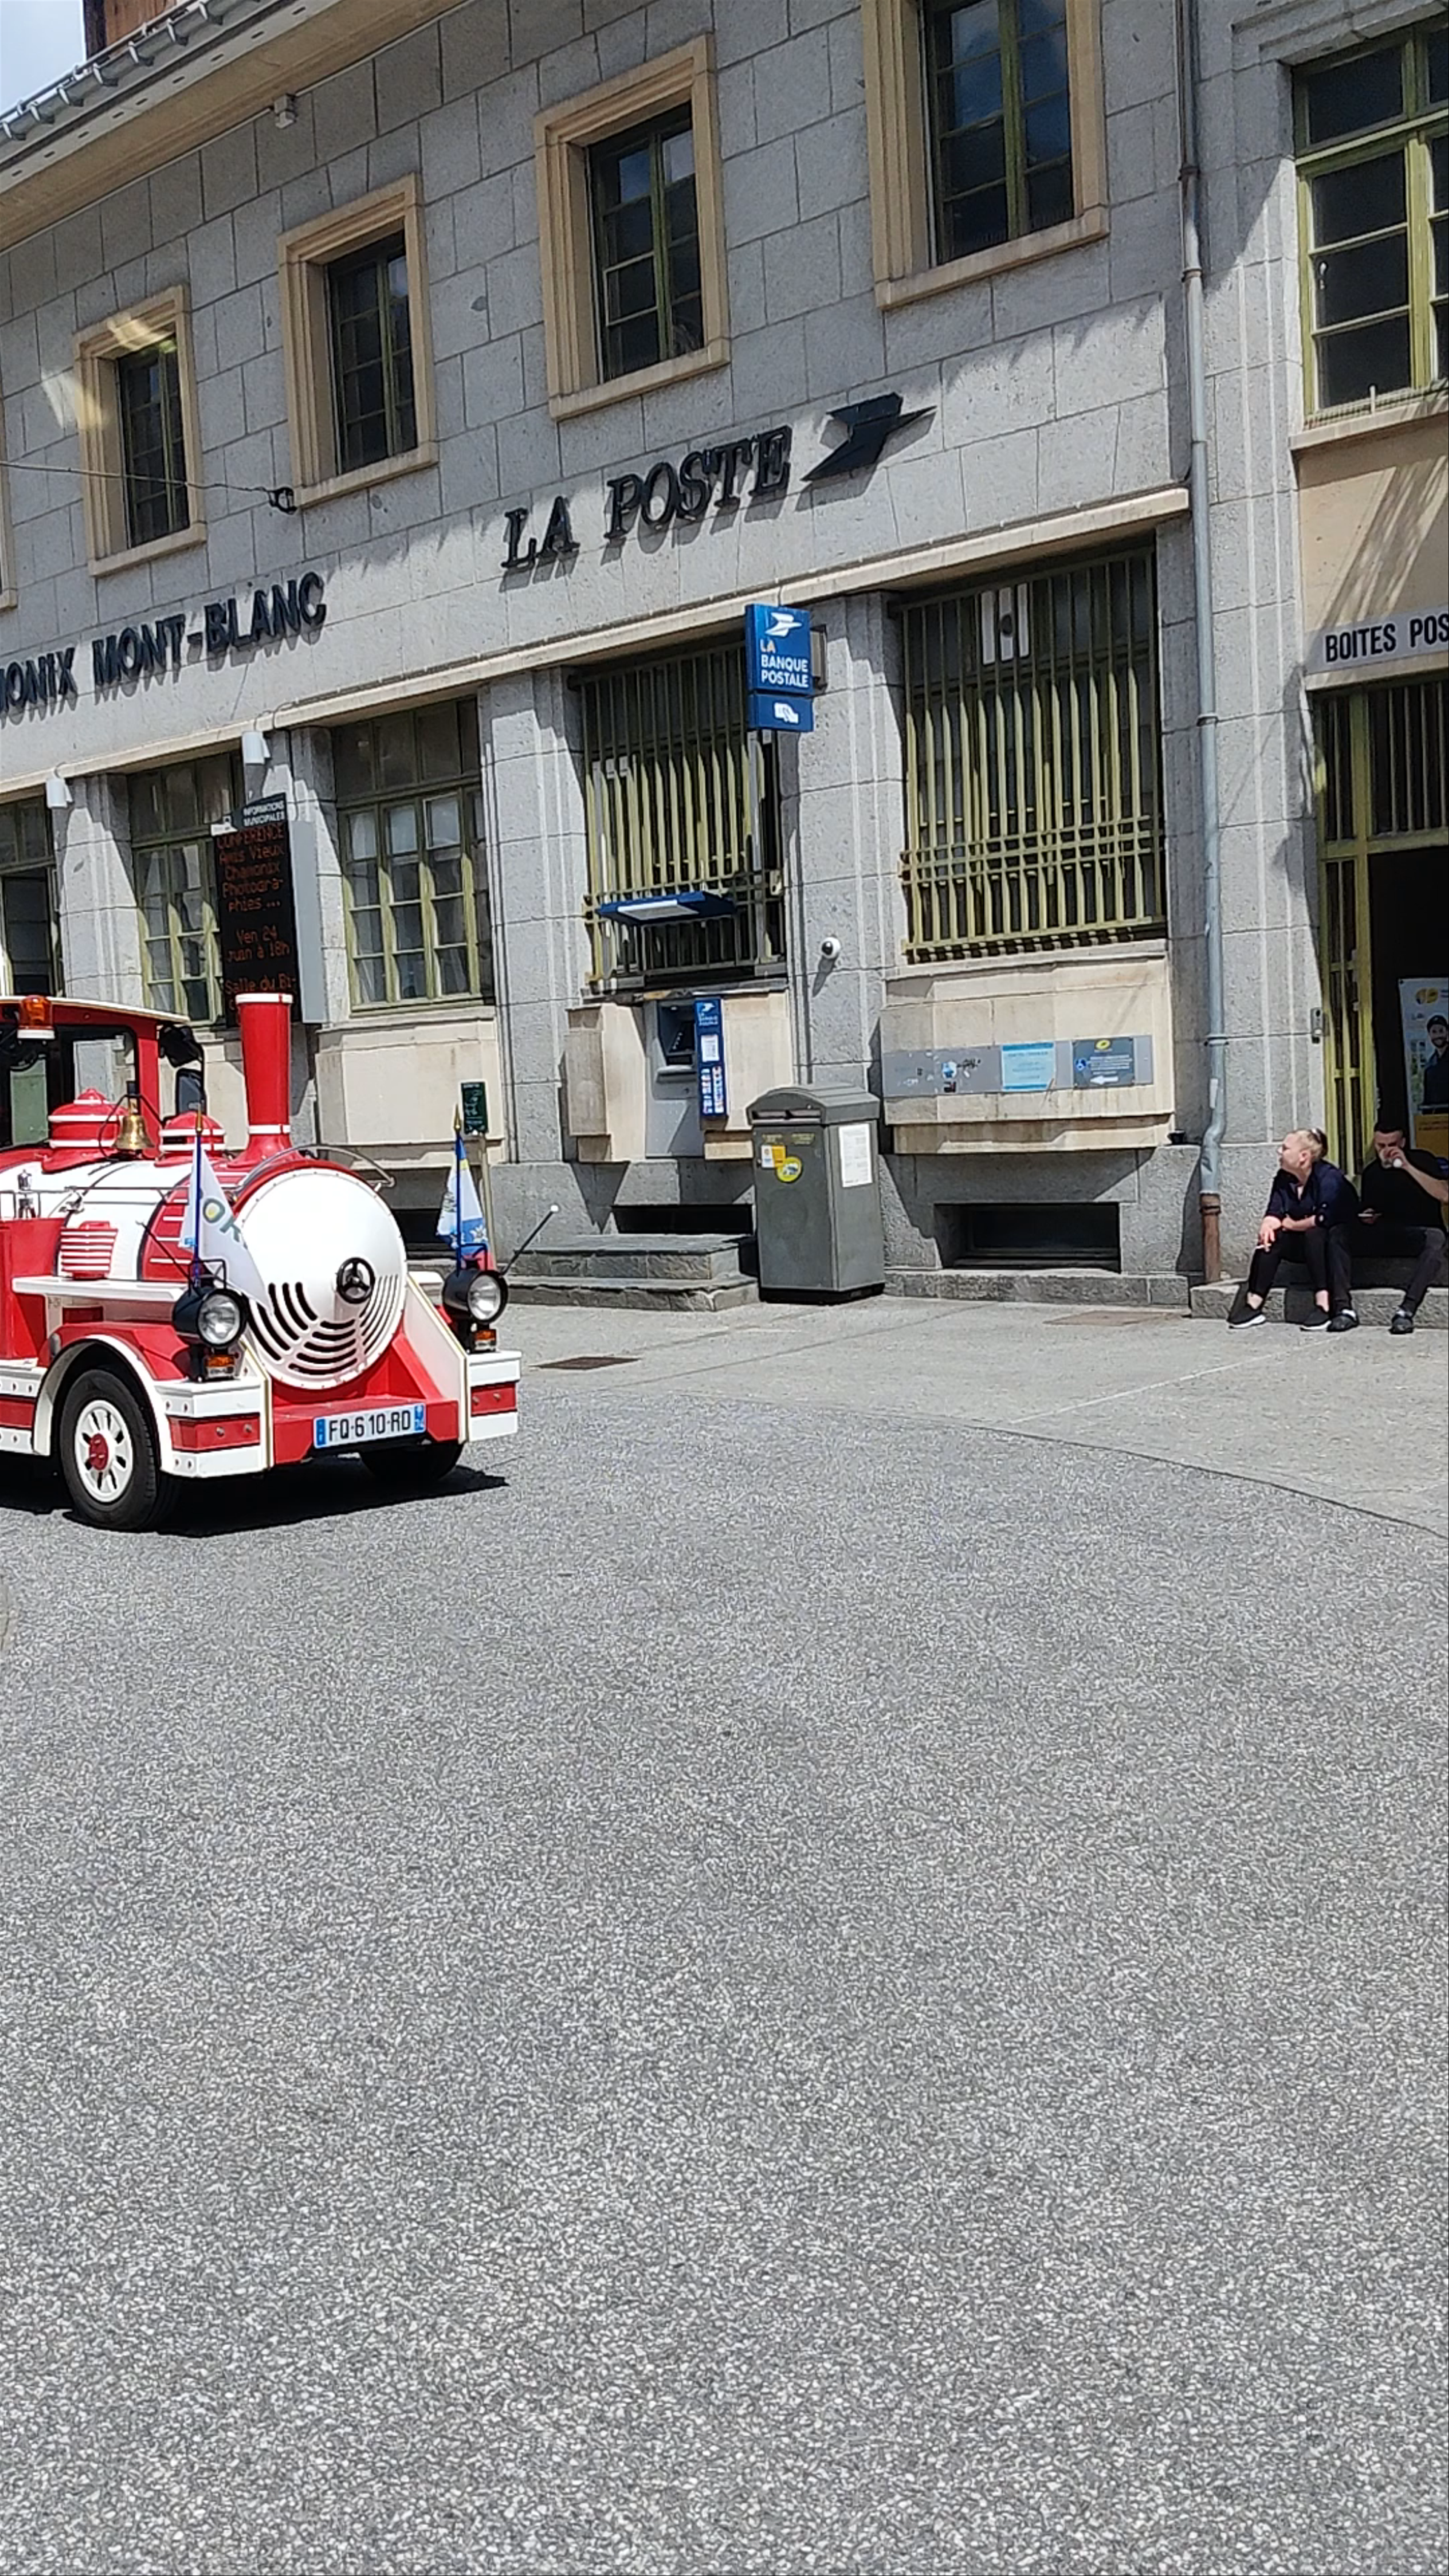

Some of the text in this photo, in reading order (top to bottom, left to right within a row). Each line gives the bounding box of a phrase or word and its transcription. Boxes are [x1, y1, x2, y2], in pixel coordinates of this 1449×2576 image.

[501, 425, 792, 568] LA POSTE
[92, 571, 327, 686] MONT-BLANC
[760, 639, 775, 652] LA
[1325, 623, 1396, 663] BOITES
[761, 654, 808, 672] BANQUE
[761, 670, 809, 687] POSTALE
[236, 923, 278, 945] Ven 24
[269, 940, 290, 958] 18h
[225, 977, 256, 995] Salle
[260, 974, 276, 991] du
